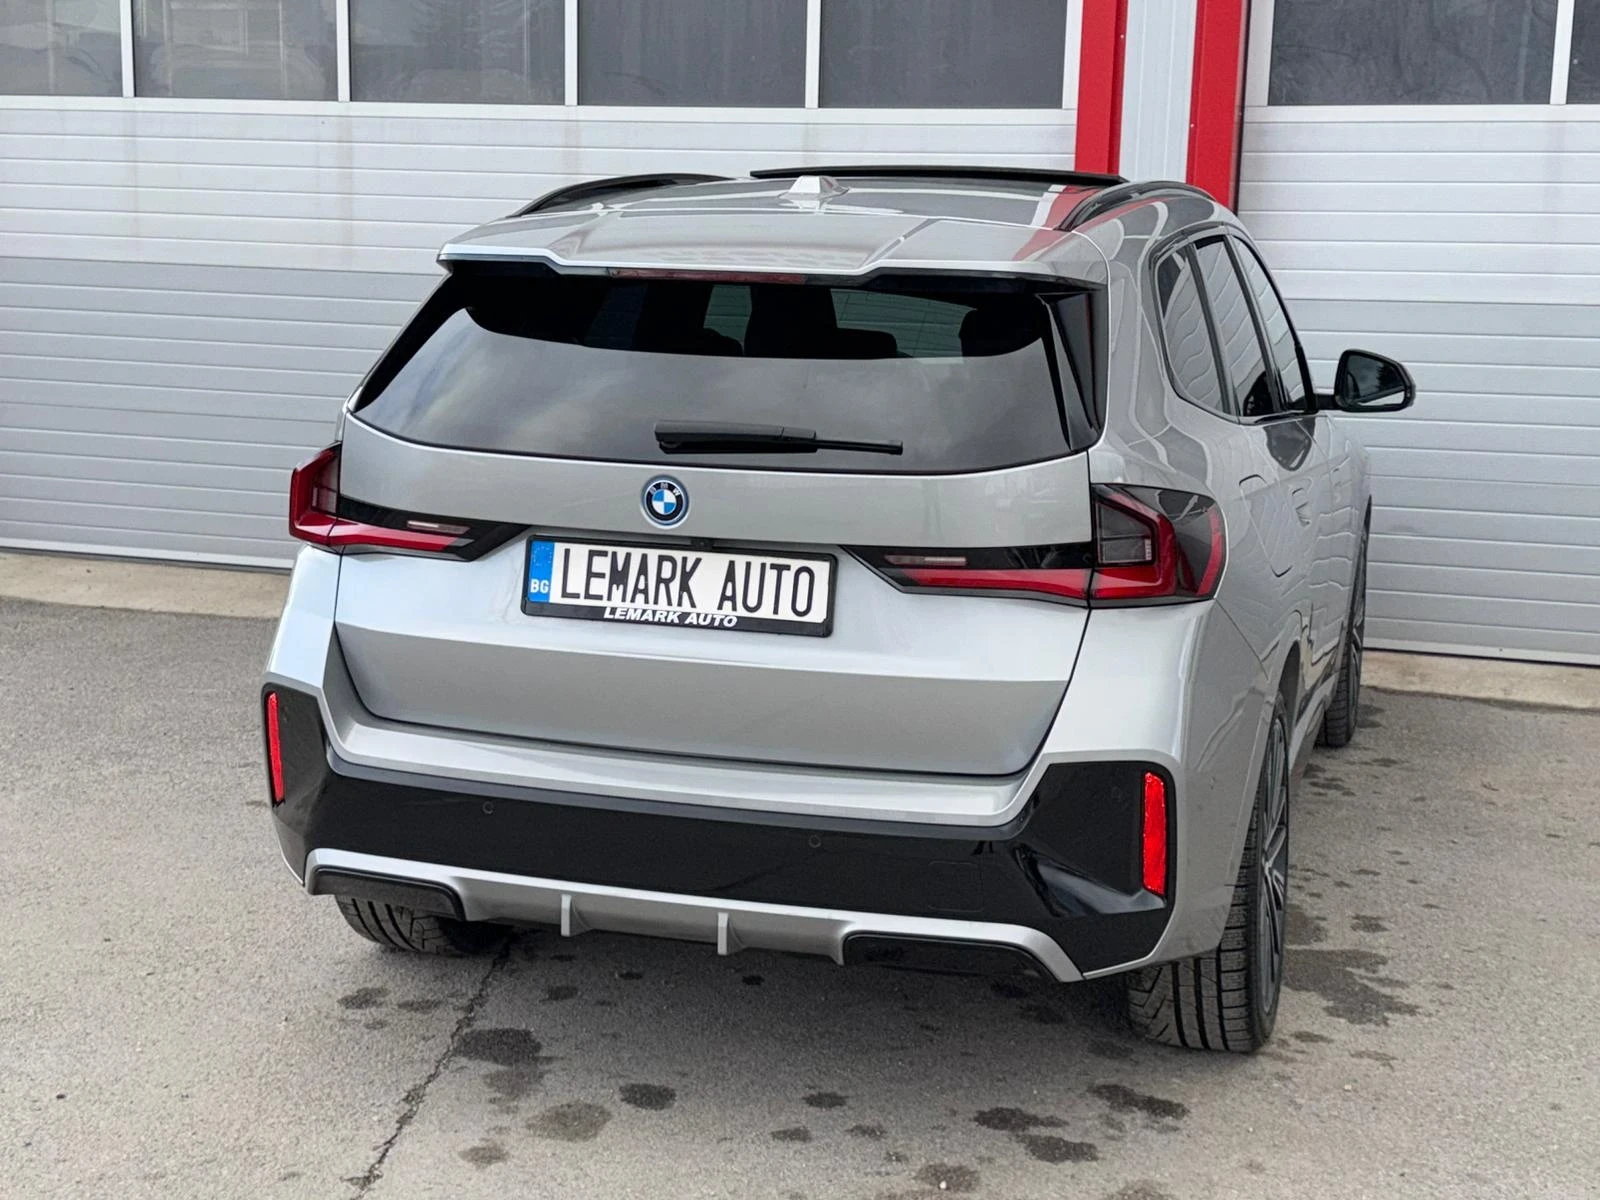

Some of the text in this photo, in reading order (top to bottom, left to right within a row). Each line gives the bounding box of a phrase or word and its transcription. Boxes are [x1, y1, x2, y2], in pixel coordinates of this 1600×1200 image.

[530, 578, 549, 593] BG
[560, 548, 815, 617] LEMARK AUTO
[604, 606, 738, 628] LEMARK AUTO
